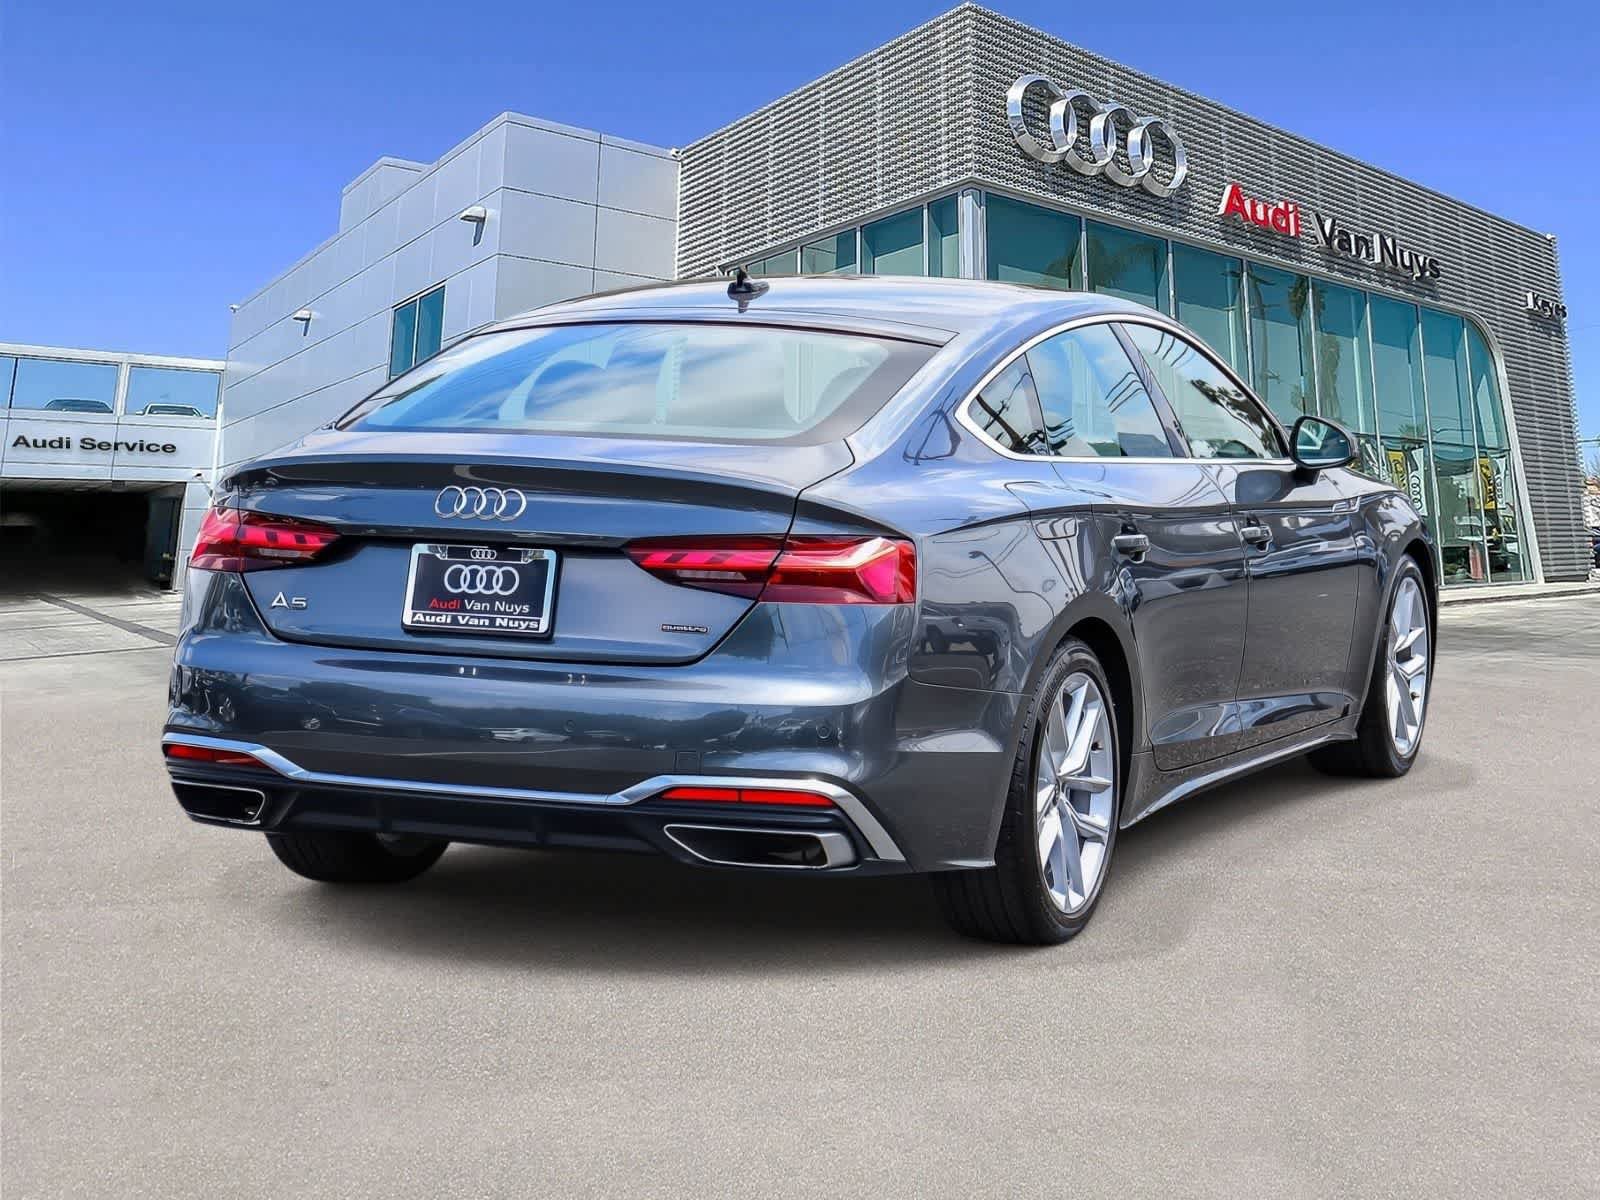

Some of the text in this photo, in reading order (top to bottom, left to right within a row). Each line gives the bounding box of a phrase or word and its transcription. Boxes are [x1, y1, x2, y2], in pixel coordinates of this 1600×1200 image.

[1217, 182, 1441, 280] Audi Van Nuys
[12, 435, 177, 453] Audi Service
[271, 592, 306, 608] A5
[429, 598, 530, 616] Audi Van Nuys
[412, 613, 539, 629] Audi Van Nuys
